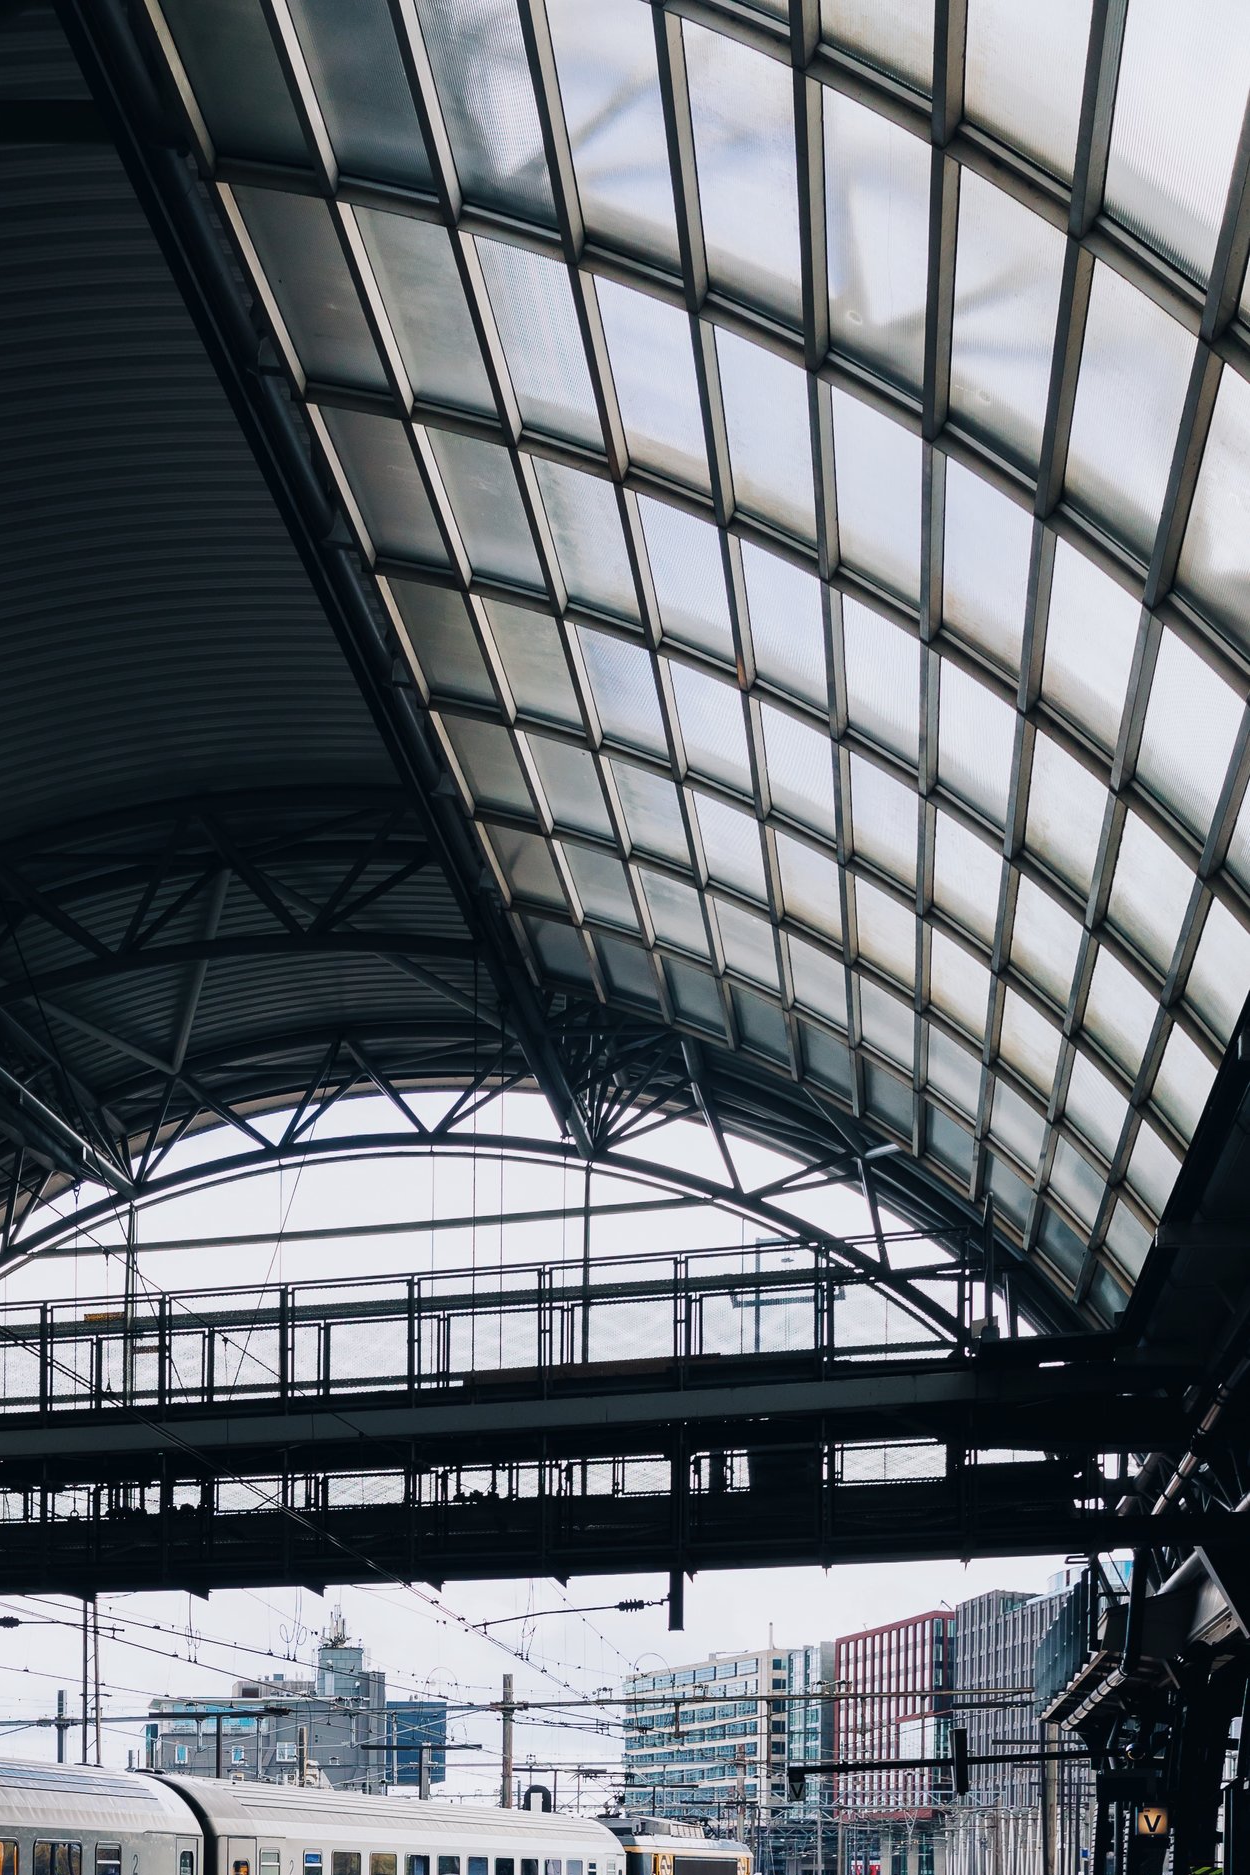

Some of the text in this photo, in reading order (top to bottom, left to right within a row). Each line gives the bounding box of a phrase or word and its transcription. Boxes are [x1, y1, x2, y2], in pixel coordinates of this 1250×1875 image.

[791, 1783, 804, 1799] V
[1144, 1814, 1161, 1832] V
[132, 1854, 139, 1875] 2
